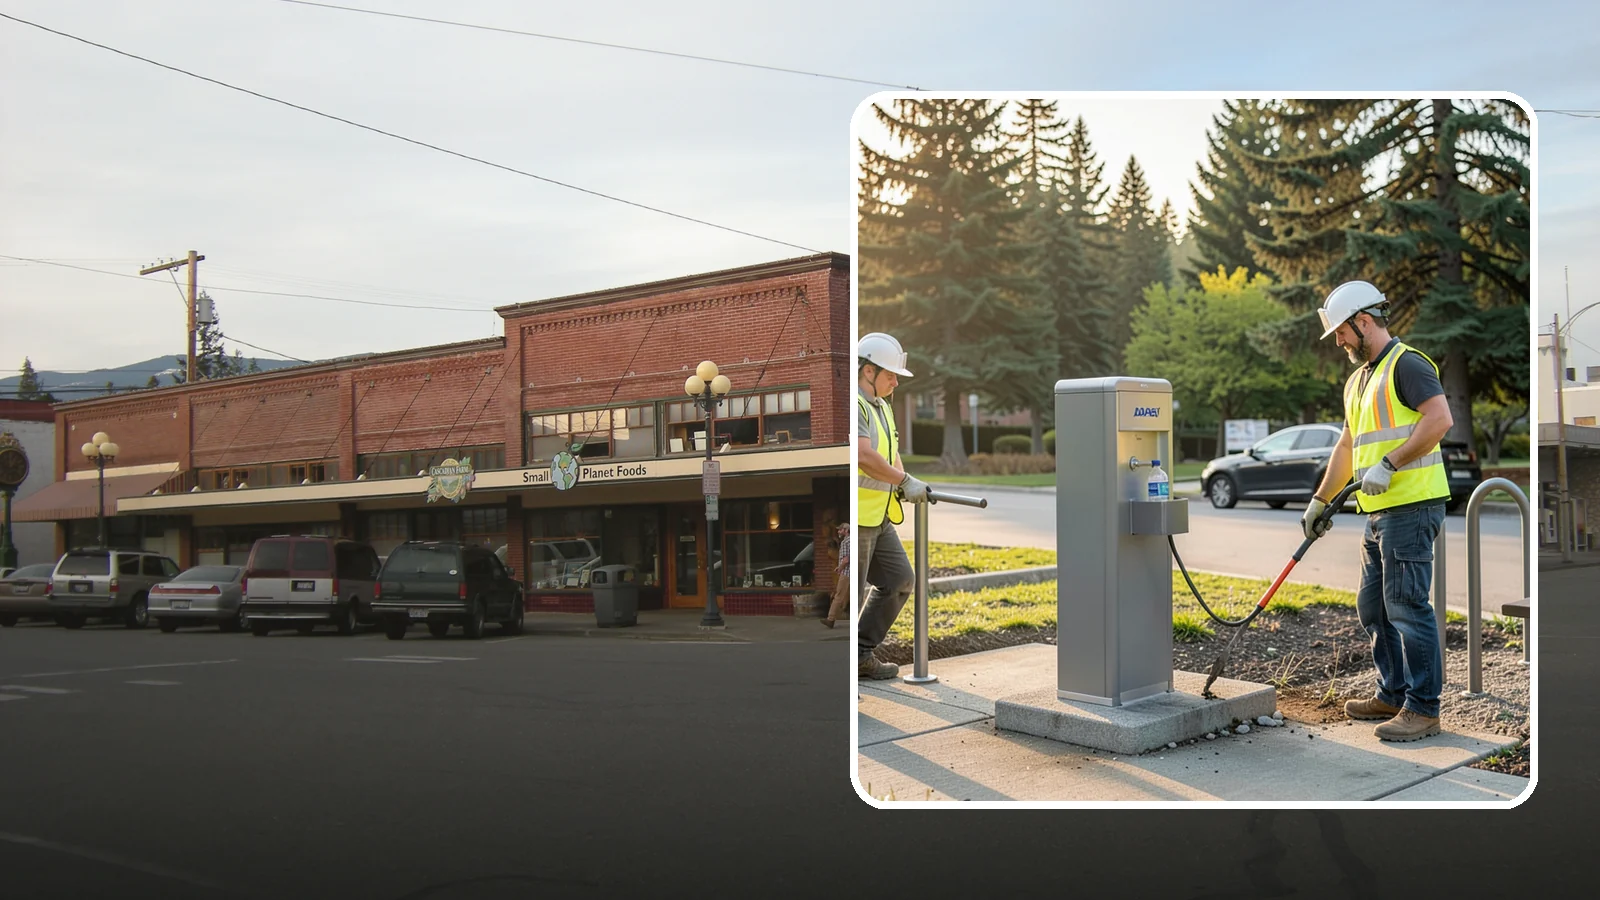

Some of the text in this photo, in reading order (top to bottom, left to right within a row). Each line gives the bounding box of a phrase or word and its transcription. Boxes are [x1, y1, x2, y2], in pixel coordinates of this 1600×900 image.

[523, 465, 647, 483] Small Planet Foods
